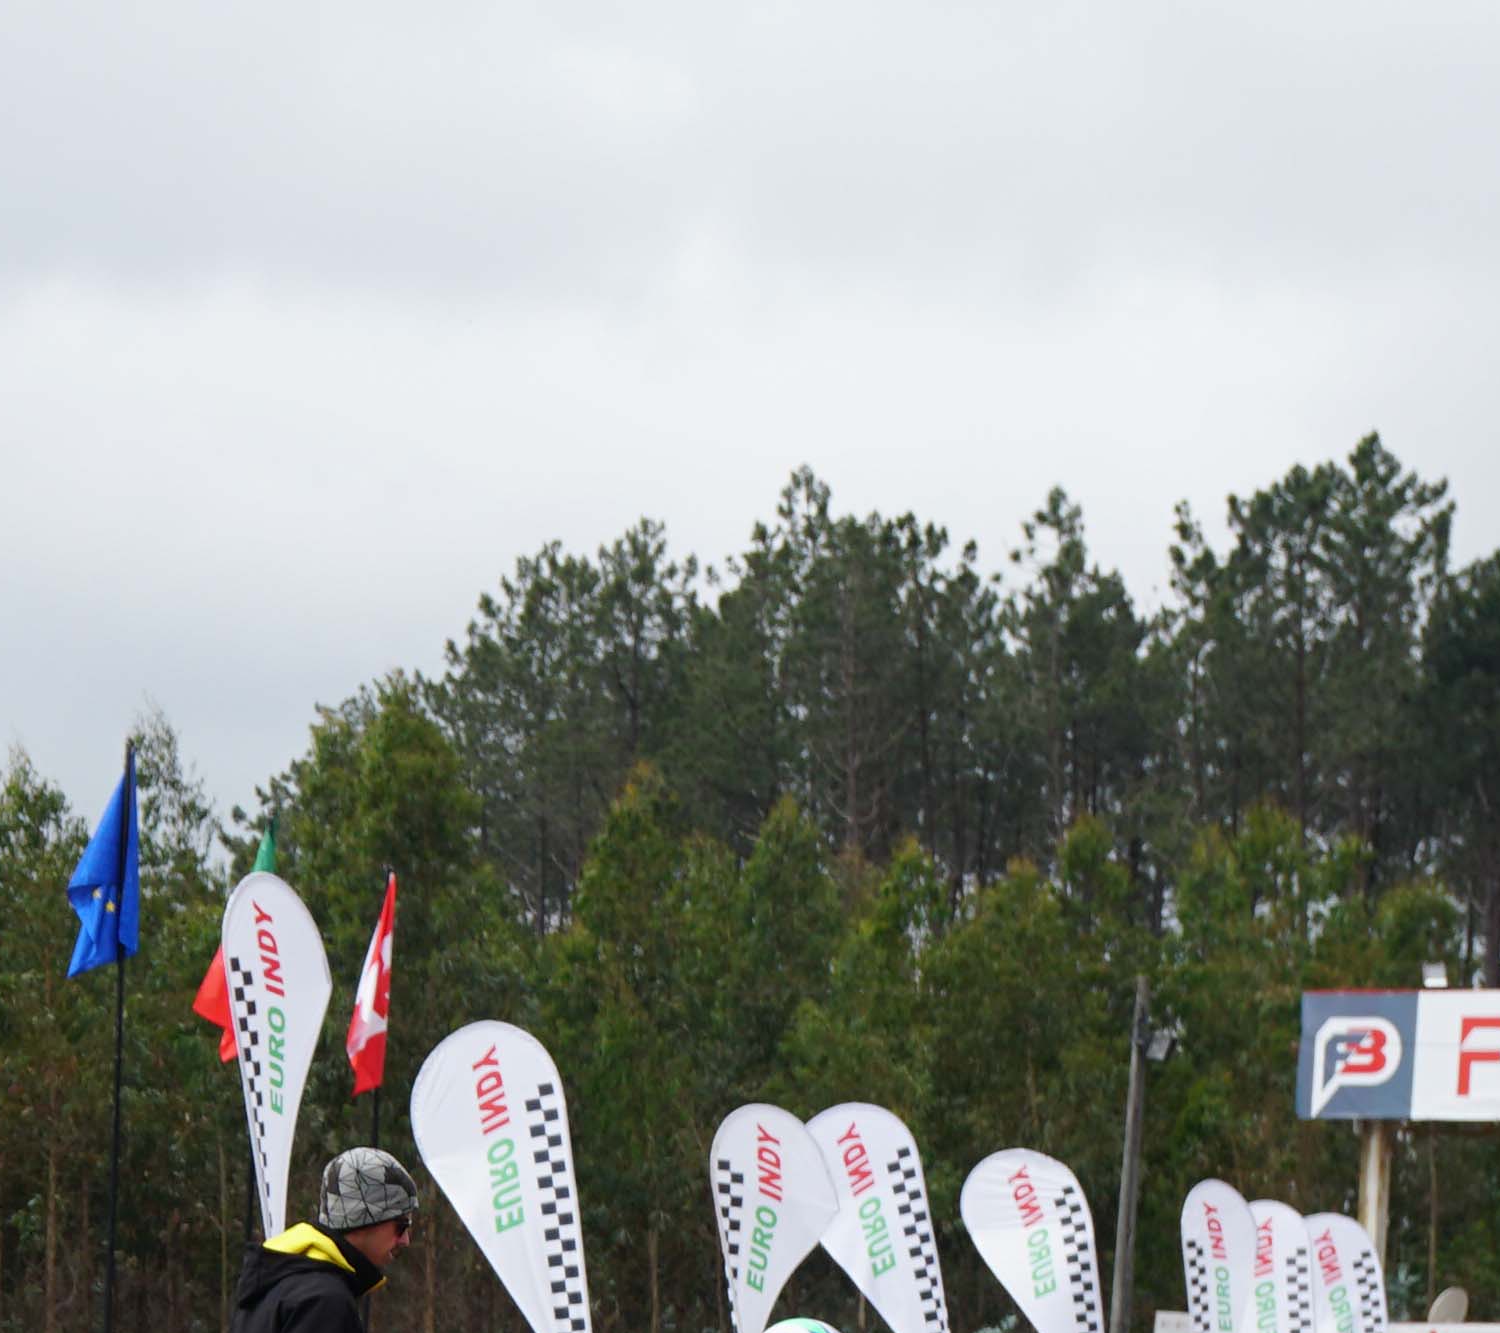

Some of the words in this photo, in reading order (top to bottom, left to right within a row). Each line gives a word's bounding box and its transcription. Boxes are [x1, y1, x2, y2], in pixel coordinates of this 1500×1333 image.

[252, 899, 285, 997] INDY
[267, 1006, 286, 1115] EURO
[756, 1123, 784, 1203] INDY
[747, 1206, 779, 1293] EURO
